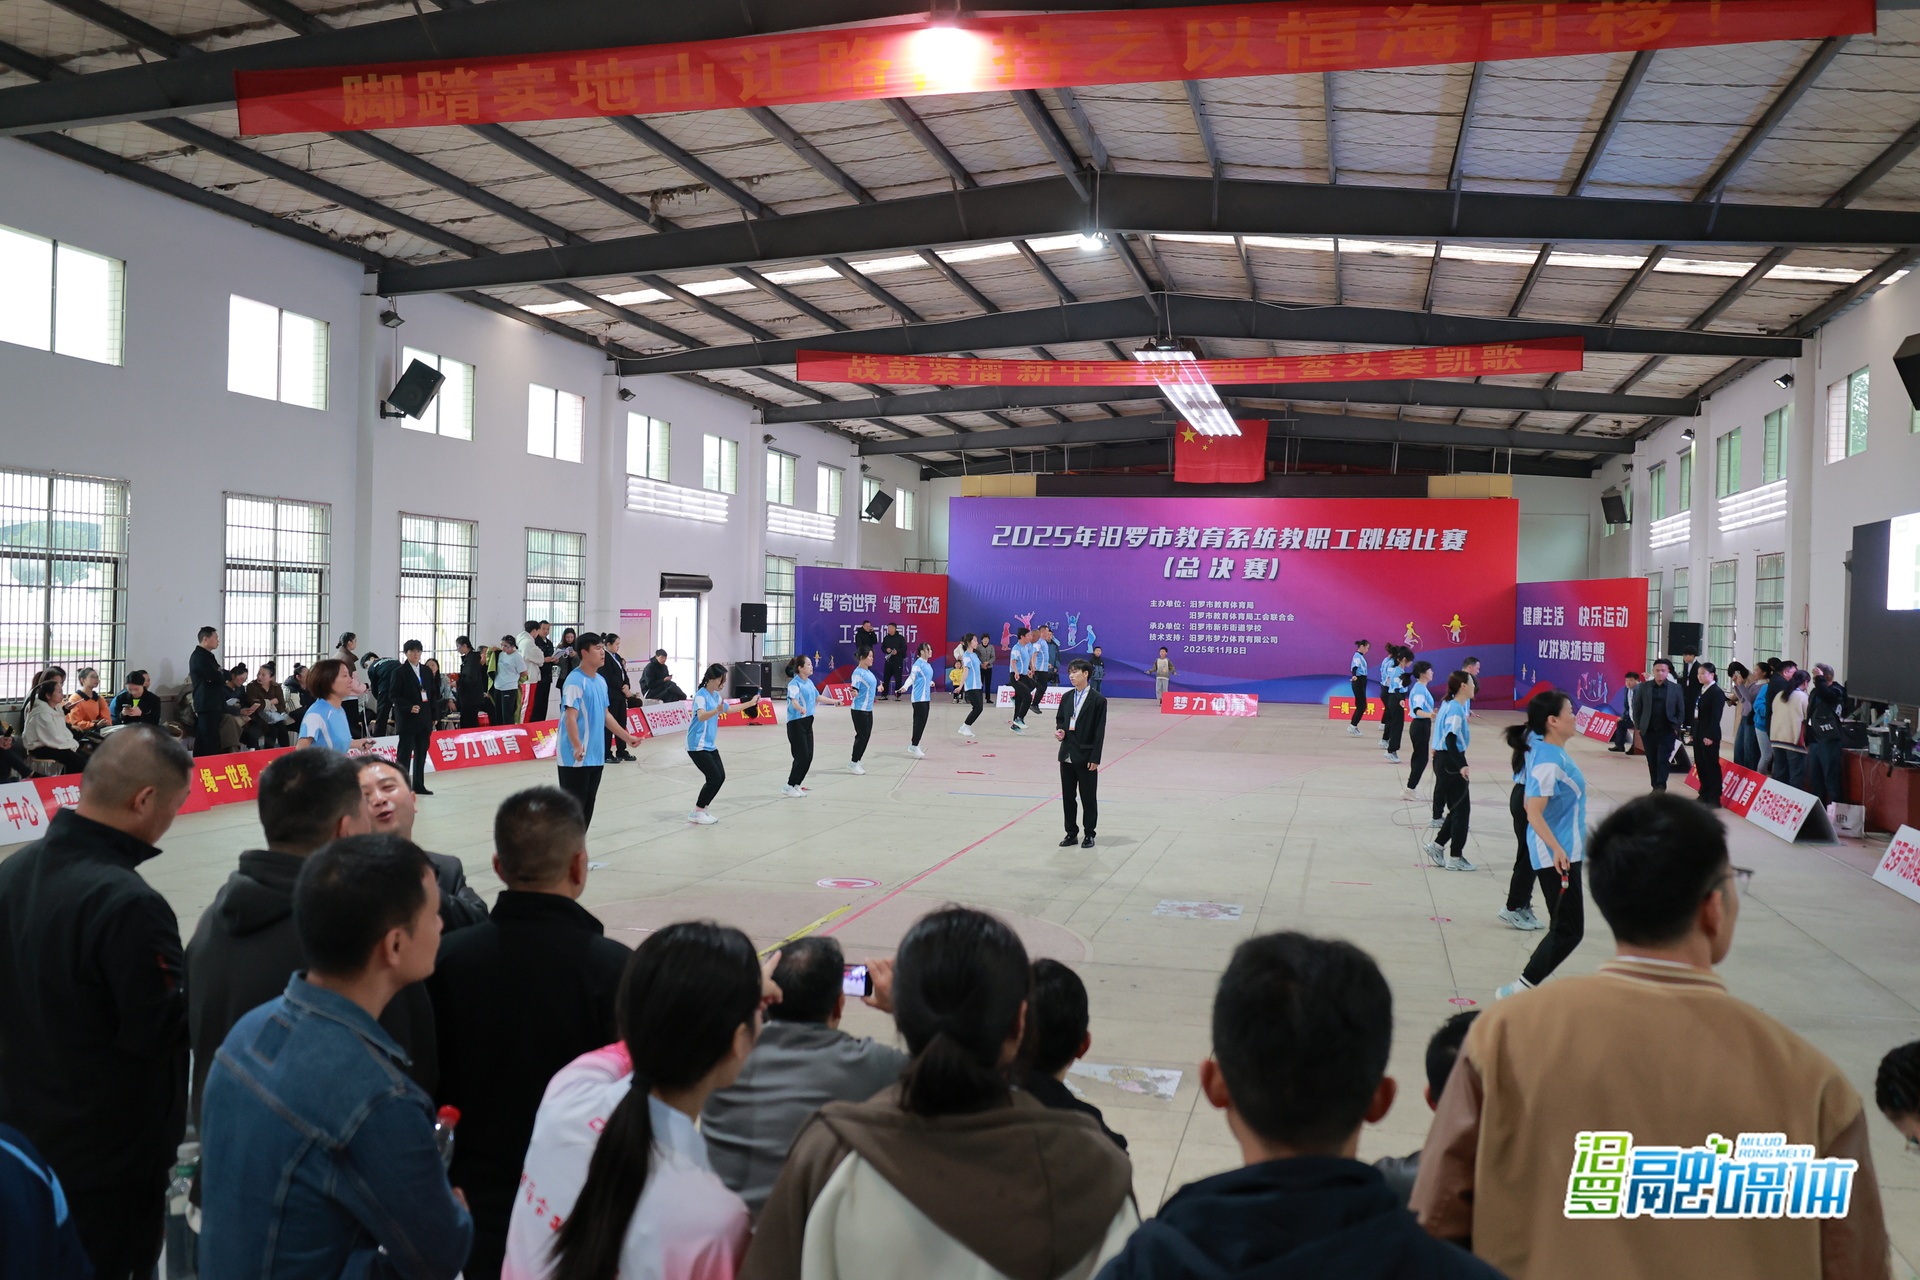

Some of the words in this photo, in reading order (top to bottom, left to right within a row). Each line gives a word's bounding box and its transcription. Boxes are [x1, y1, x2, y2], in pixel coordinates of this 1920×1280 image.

[991, 525, 1468, 551] 2025年汨罗市教育系统教职工跳绳比赛
[1189, 611, 1295, 622] 汨罗市教育体育局工会联合会
[1522, 606, 1565, 626] 健康生活
[1578, 605, 1629, 628] 快乐运动
[1183, 645, 1247, 654] 2025年11月8日
[1538, 639, 1606, 663] 比拼激扬梦想
[1173, 696, 1247, 711] 梦力体育
[1333, 702, 1375, 715] 一绳一界
[436, 733, 521, 762] 梦力体育
